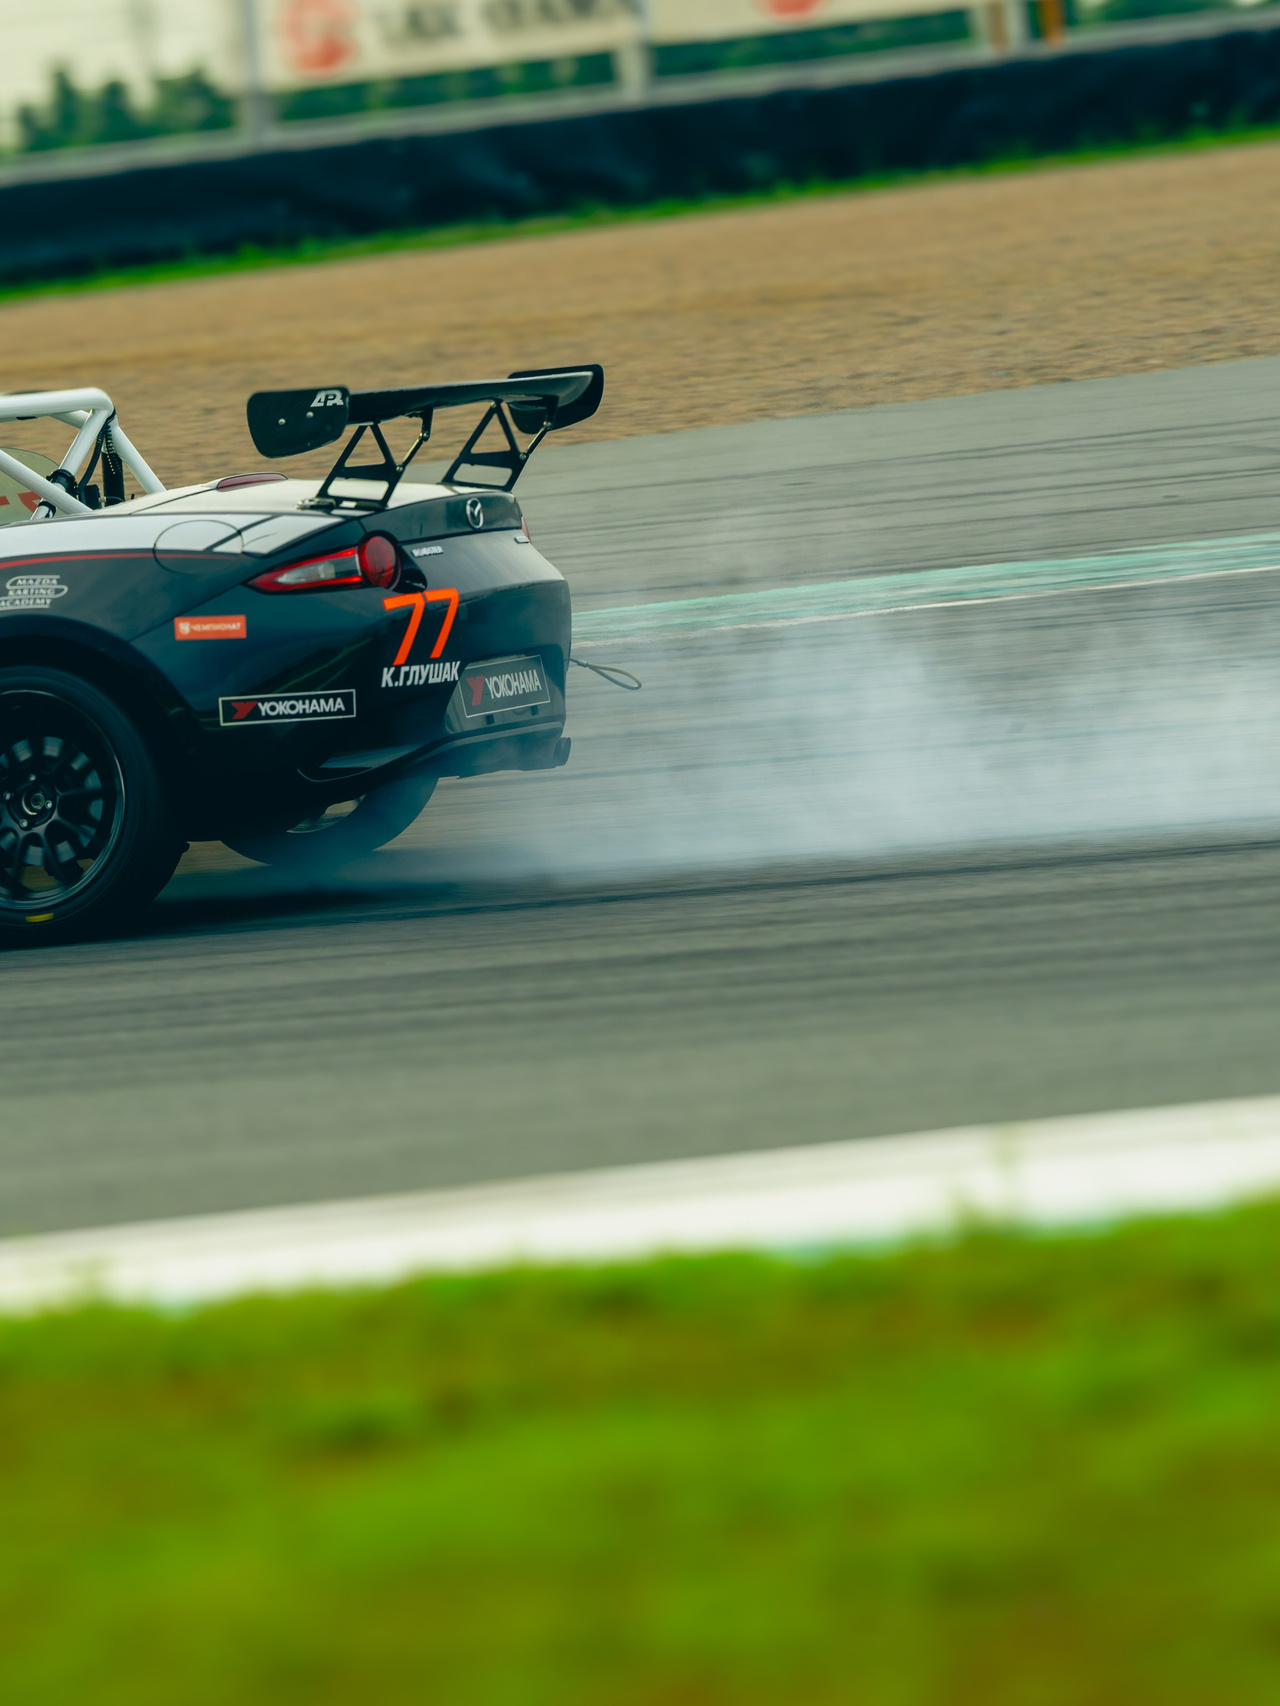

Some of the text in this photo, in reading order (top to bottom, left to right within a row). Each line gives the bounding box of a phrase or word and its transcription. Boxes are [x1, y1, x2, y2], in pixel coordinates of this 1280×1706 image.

[382, 588, 459, 666] 77
[381, 661, 461, 688] К.ГЛУШАК
[485, 669, 542, 699] YOKOHAMA
[258, 697, 345, 716] YOKOHAMA
